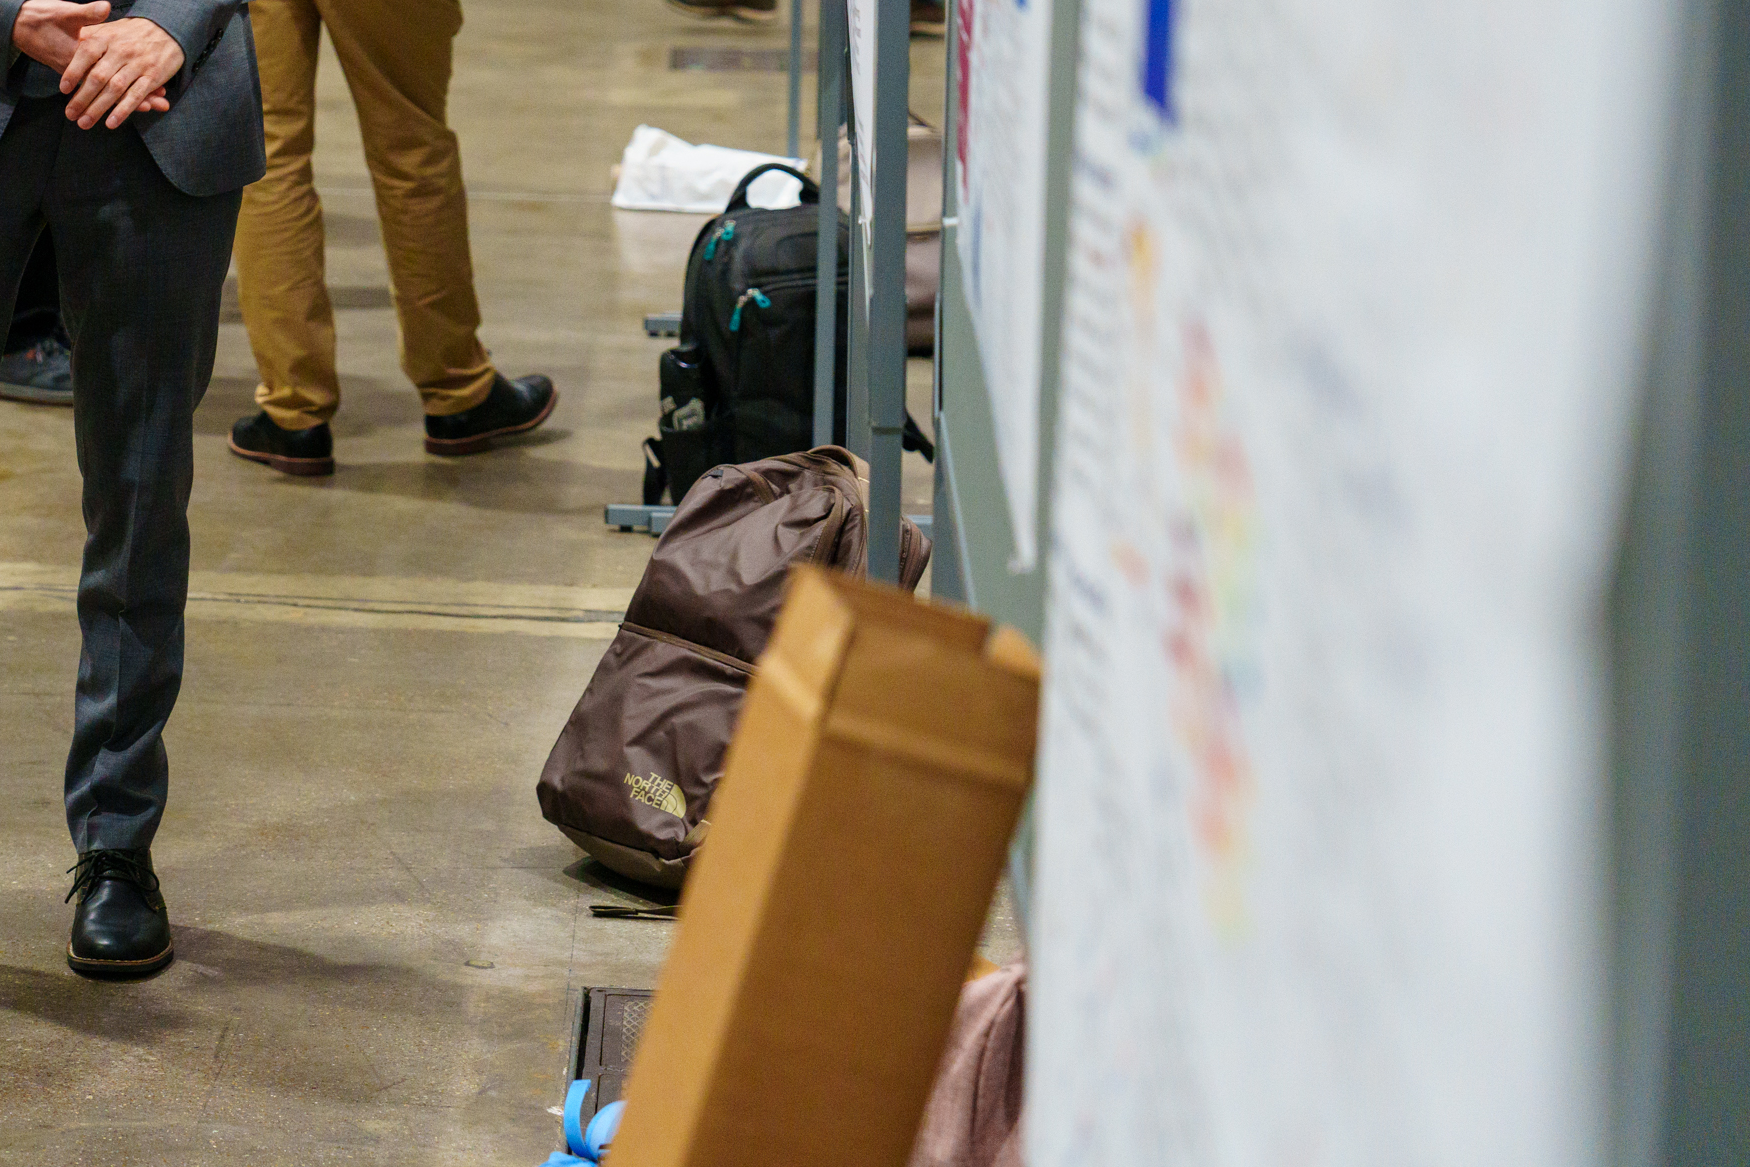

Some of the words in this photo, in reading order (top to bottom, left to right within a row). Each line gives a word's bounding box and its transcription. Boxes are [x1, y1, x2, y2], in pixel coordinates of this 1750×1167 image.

[623, 772, 670, 799] NORTH
[648, 771, 674, 793] THE
[629, 787, 664, 809] FACE
